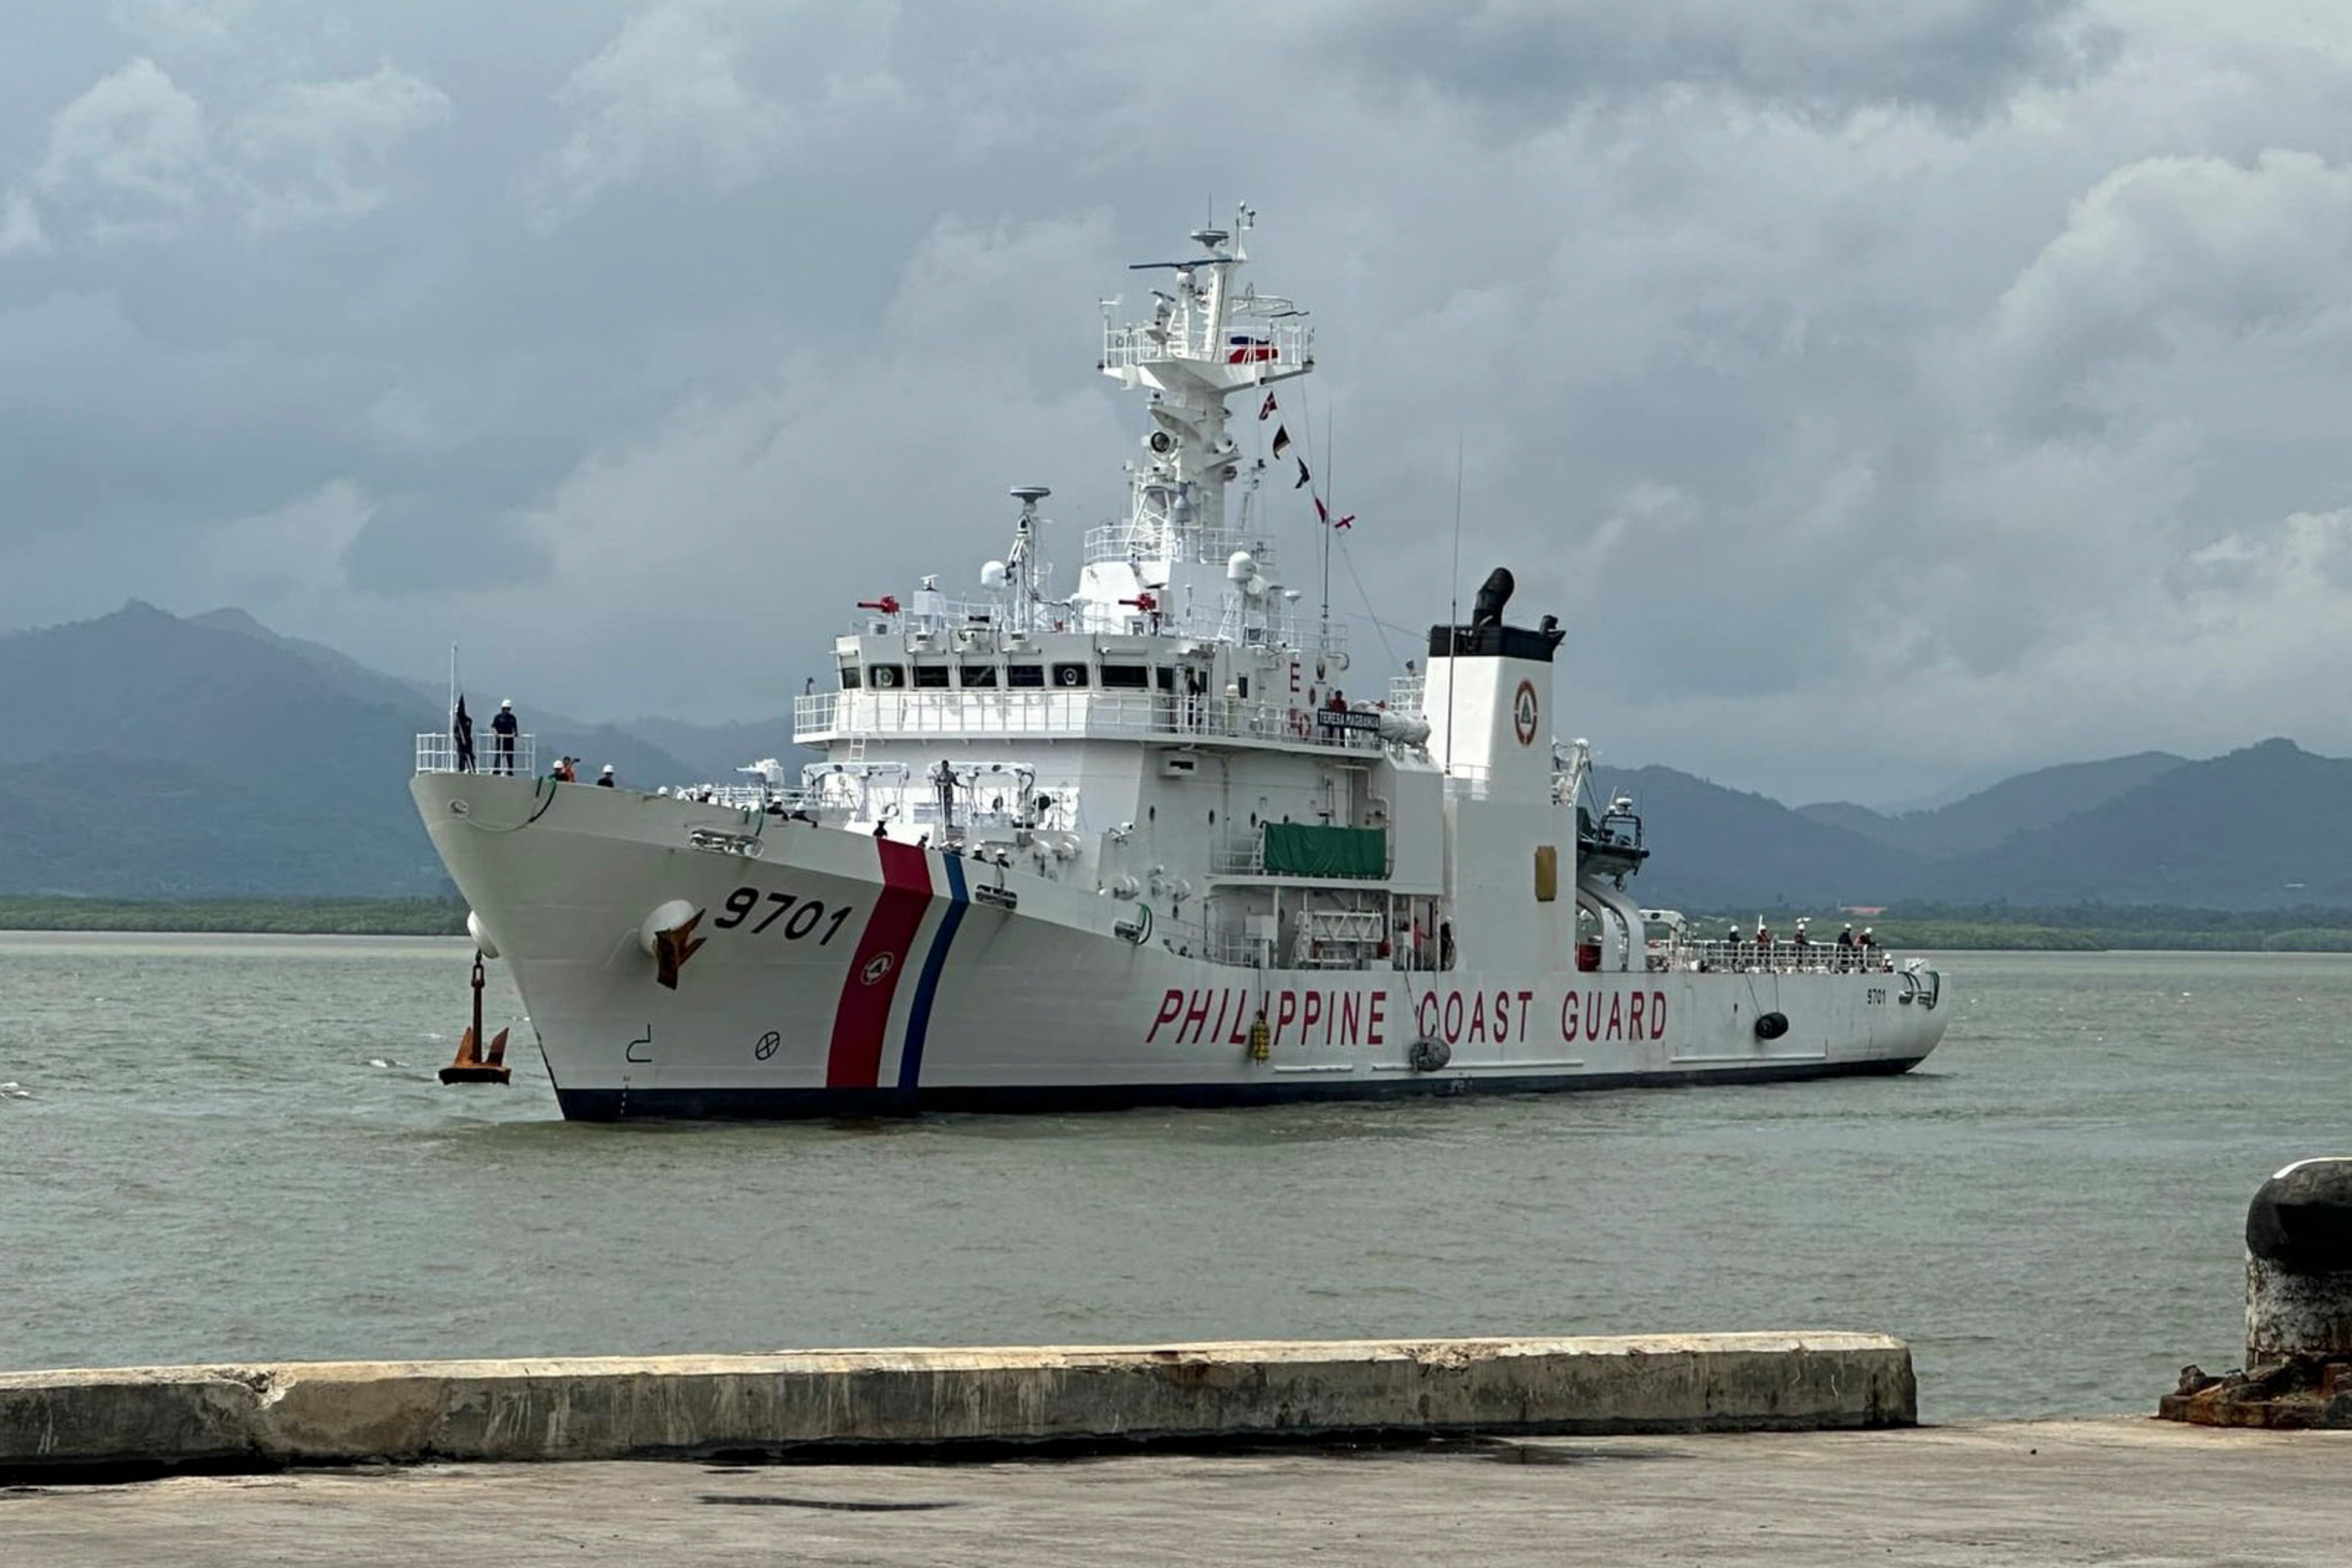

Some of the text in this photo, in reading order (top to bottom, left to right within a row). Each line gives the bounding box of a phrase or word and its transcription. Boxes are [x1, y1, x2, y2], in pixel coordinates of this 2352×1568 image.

[714, 887, 853, 946] 9701
[1146, 989, 1667, 1046] PHILIPPINE COAST GUARD
[1867, 988, 1885, 1005] 9701
